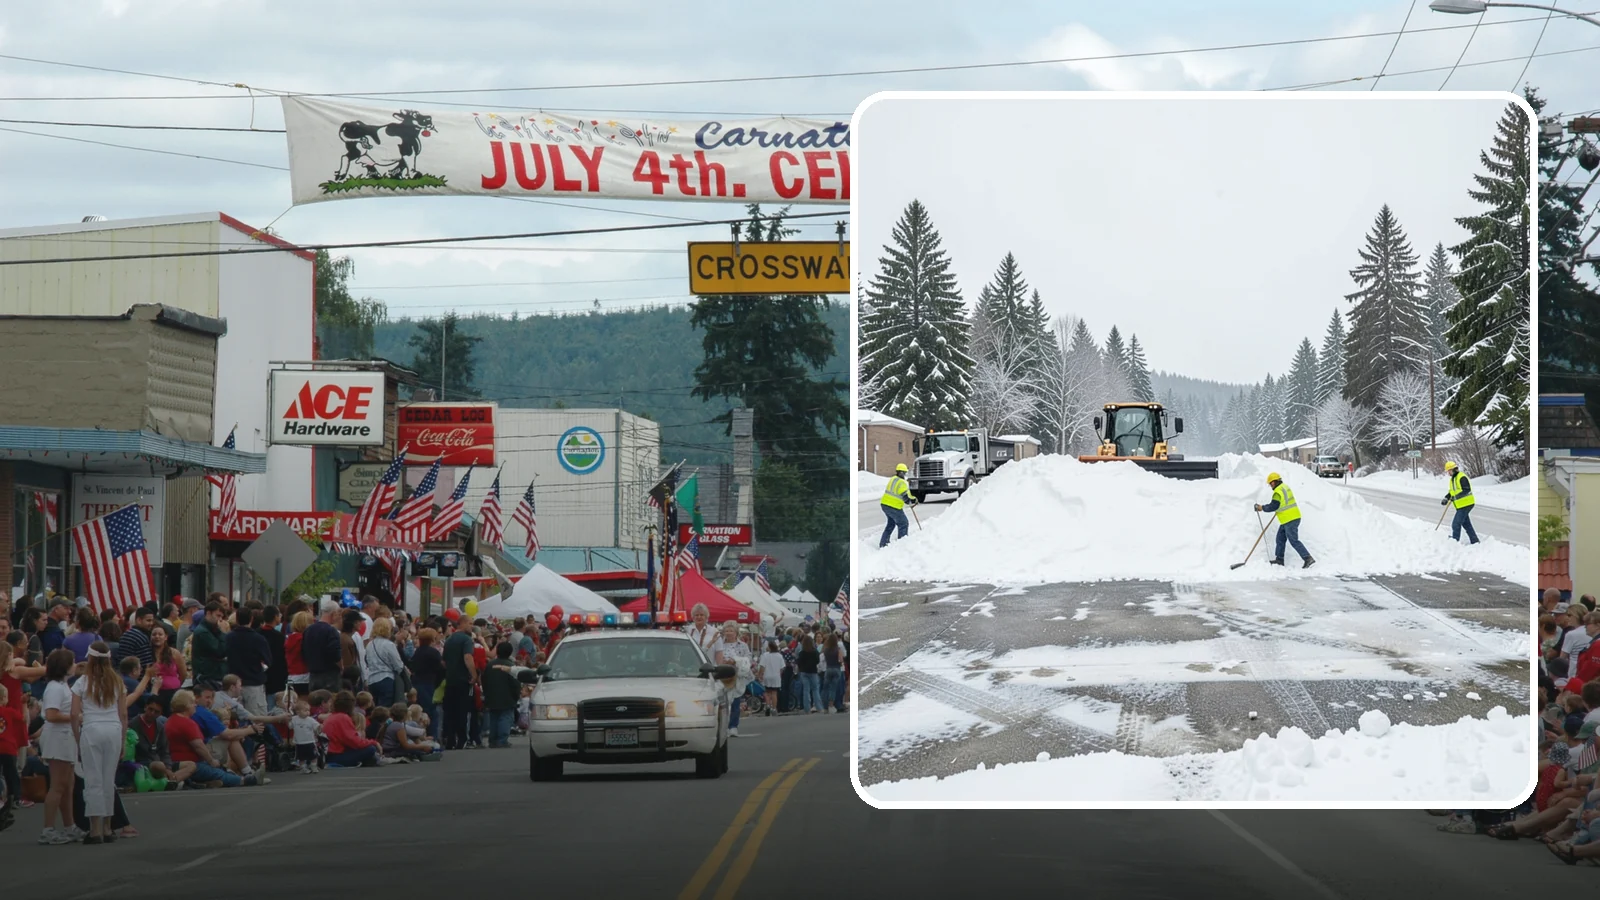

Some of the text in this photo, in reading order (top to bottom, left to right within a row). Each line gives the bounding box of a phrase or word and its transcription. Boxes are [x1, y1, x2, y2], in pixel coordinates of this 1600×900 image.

[481, 141, 605, 192] JULY
[632, 150, 746, 197] 4th.
[697, 254, 850, 280] CROSSWA
[283, 380, 373, 419] ACE
[406, 409, 452, 421] CEDAR
[284, 421, 370, 436] Hardware
[353, 467, 386, 479] Simpl
[96, 485, 124, 495] Vincent
[126, 486, 136, 495] de
[138, 486, 155, 495] Paul
[688, 526, 741, 535] CRNATION
[699, 535, 730, 543] GLASS
